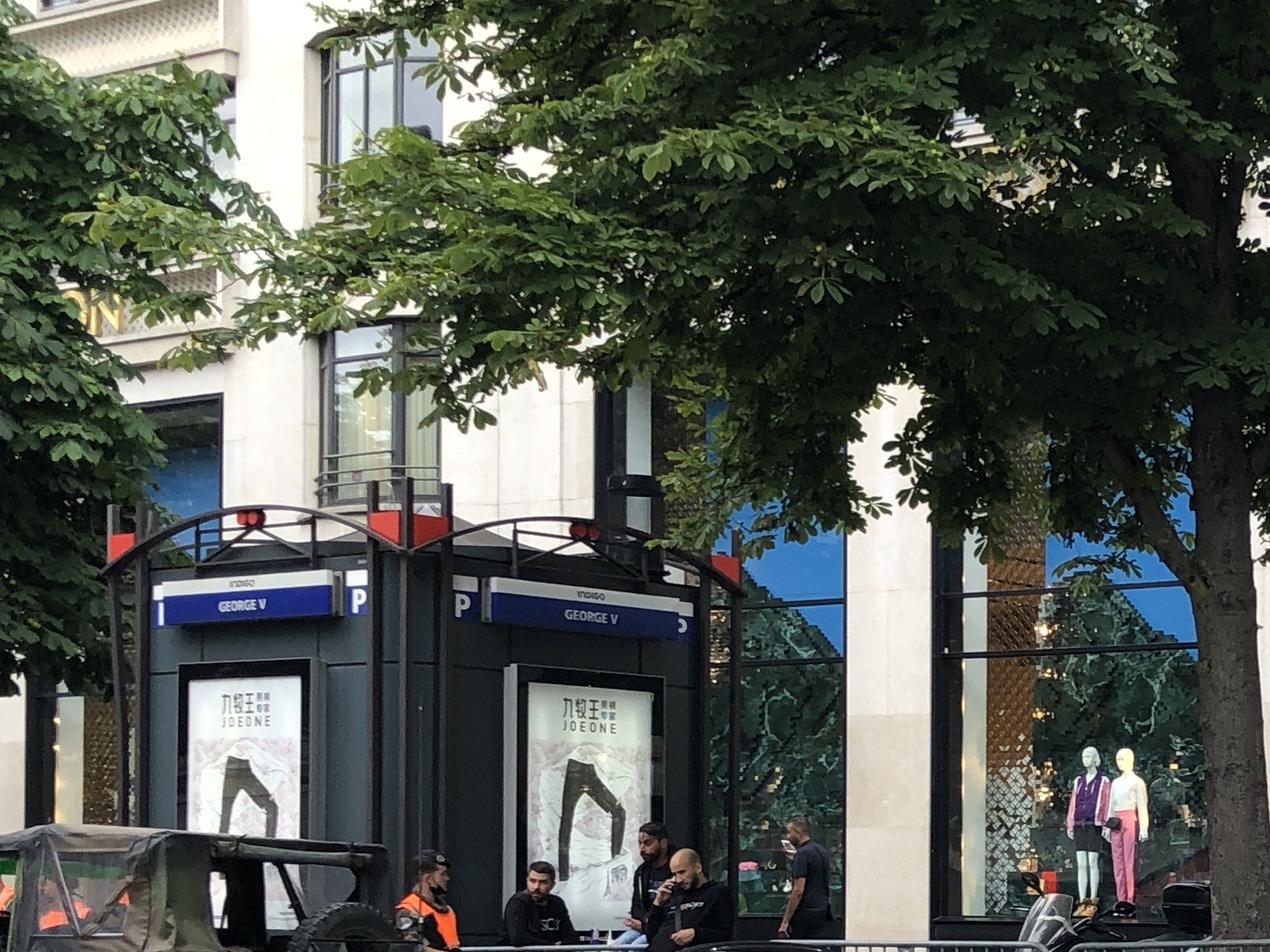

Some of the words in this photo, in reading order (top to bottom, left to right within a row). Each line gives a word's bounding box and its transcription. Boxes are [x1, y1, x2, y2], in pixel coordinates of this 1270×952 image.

[351, 589, 367, 614] P
[577, 590, 606, 601] INDIGO
[218, 599, 257, 612] GEORGE
[257, 598, 267, 610] V
[455, 593, 472, 618] P
[564, 609, 608, 624] GEORGE
[610, 613, 619, 625] V
[562, 697, 599, 720] 九牧王
[221, 715, 271, 728] JOEONE
[562, 720, 617, 735] JOEONE
